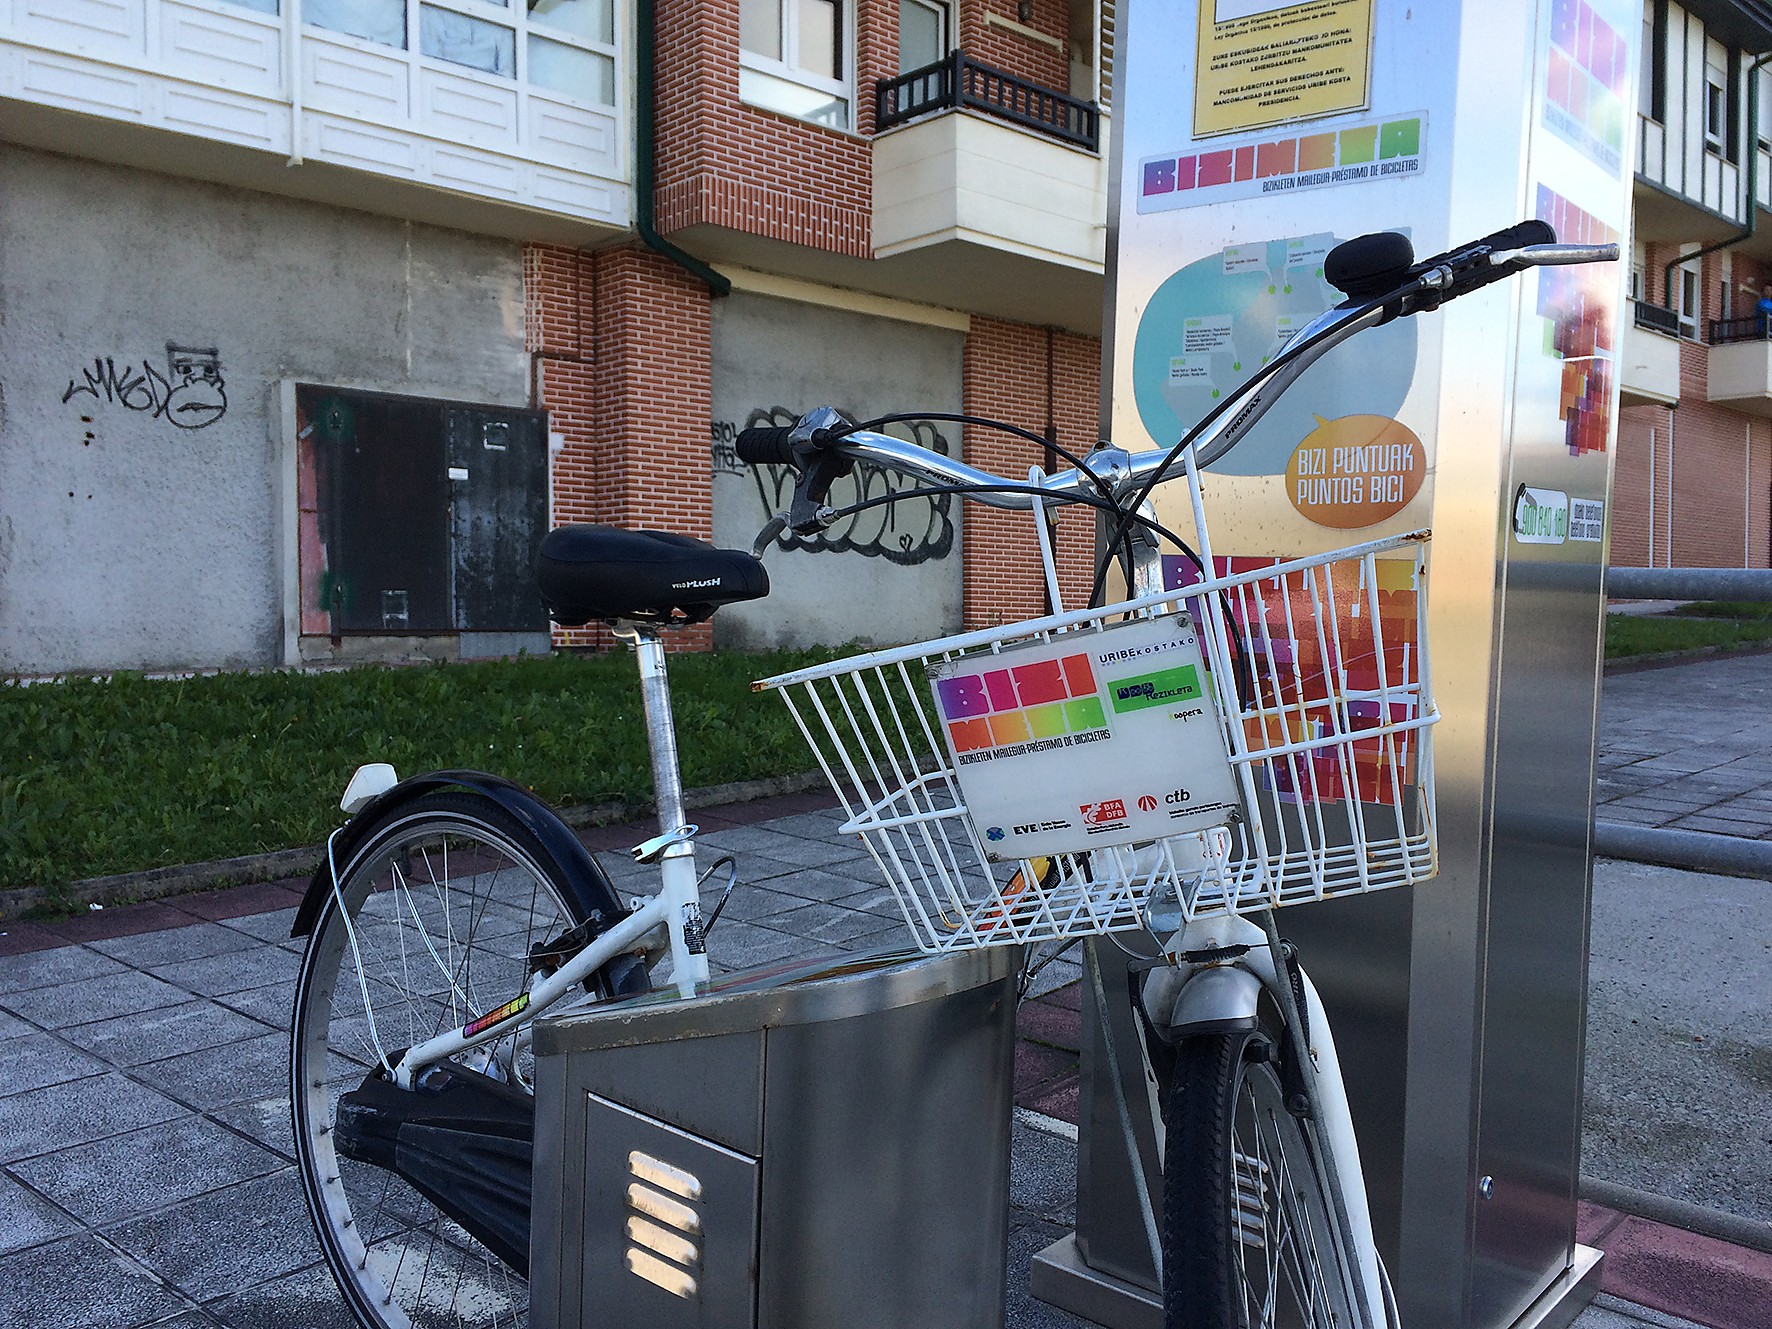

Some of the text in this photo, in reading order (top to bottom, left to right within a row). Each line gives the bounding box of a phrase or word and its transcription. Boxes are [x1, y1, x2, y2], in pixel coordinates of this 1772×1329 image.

[1275, 77, 1288, 85] SUS
[1370, 164, 1379, 177] DE
[1380, 158, 1419, 176] BICICLETAS
[1225, 395, 1261, 439] PROMAX
[1298, 443, 1414, 476] BIZI PUNTUAK
[1297, 474, 1404, 506] PUNTOS BICI
[687, 577, 721, 589] PLUSH
[1064, 736, 1074, 748] DE
[1074, 728, 1112, 745] BICICLETAS
[1165, 788, 1191, 804] ctb
[1103, 802, 1121, 812] BFA
[1105, 809, 1124, 819] DFB
[1013, 823, 1038, 835] EVE
